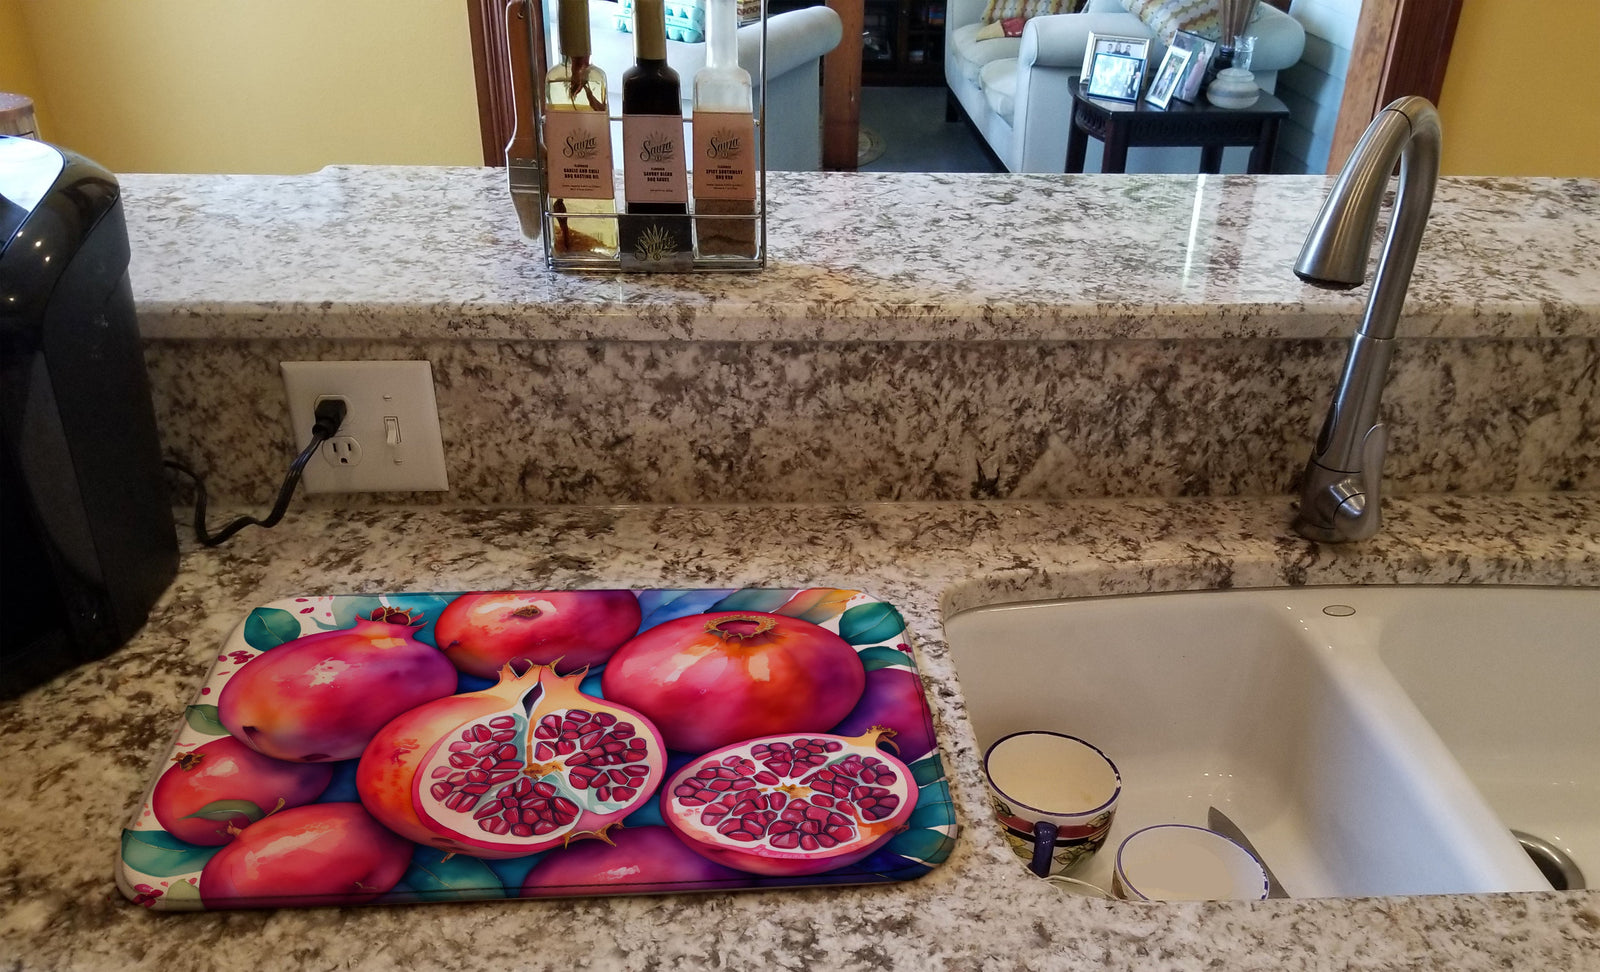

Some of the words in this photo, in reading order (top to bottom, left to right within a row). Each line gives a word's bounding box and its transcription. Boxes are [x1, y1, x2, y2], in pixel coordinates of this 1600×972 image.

[563, 136, 598, 158] Sauza
[640, 140, 674, 161] Sauza
[707, 137, 740, 158] Sauza
